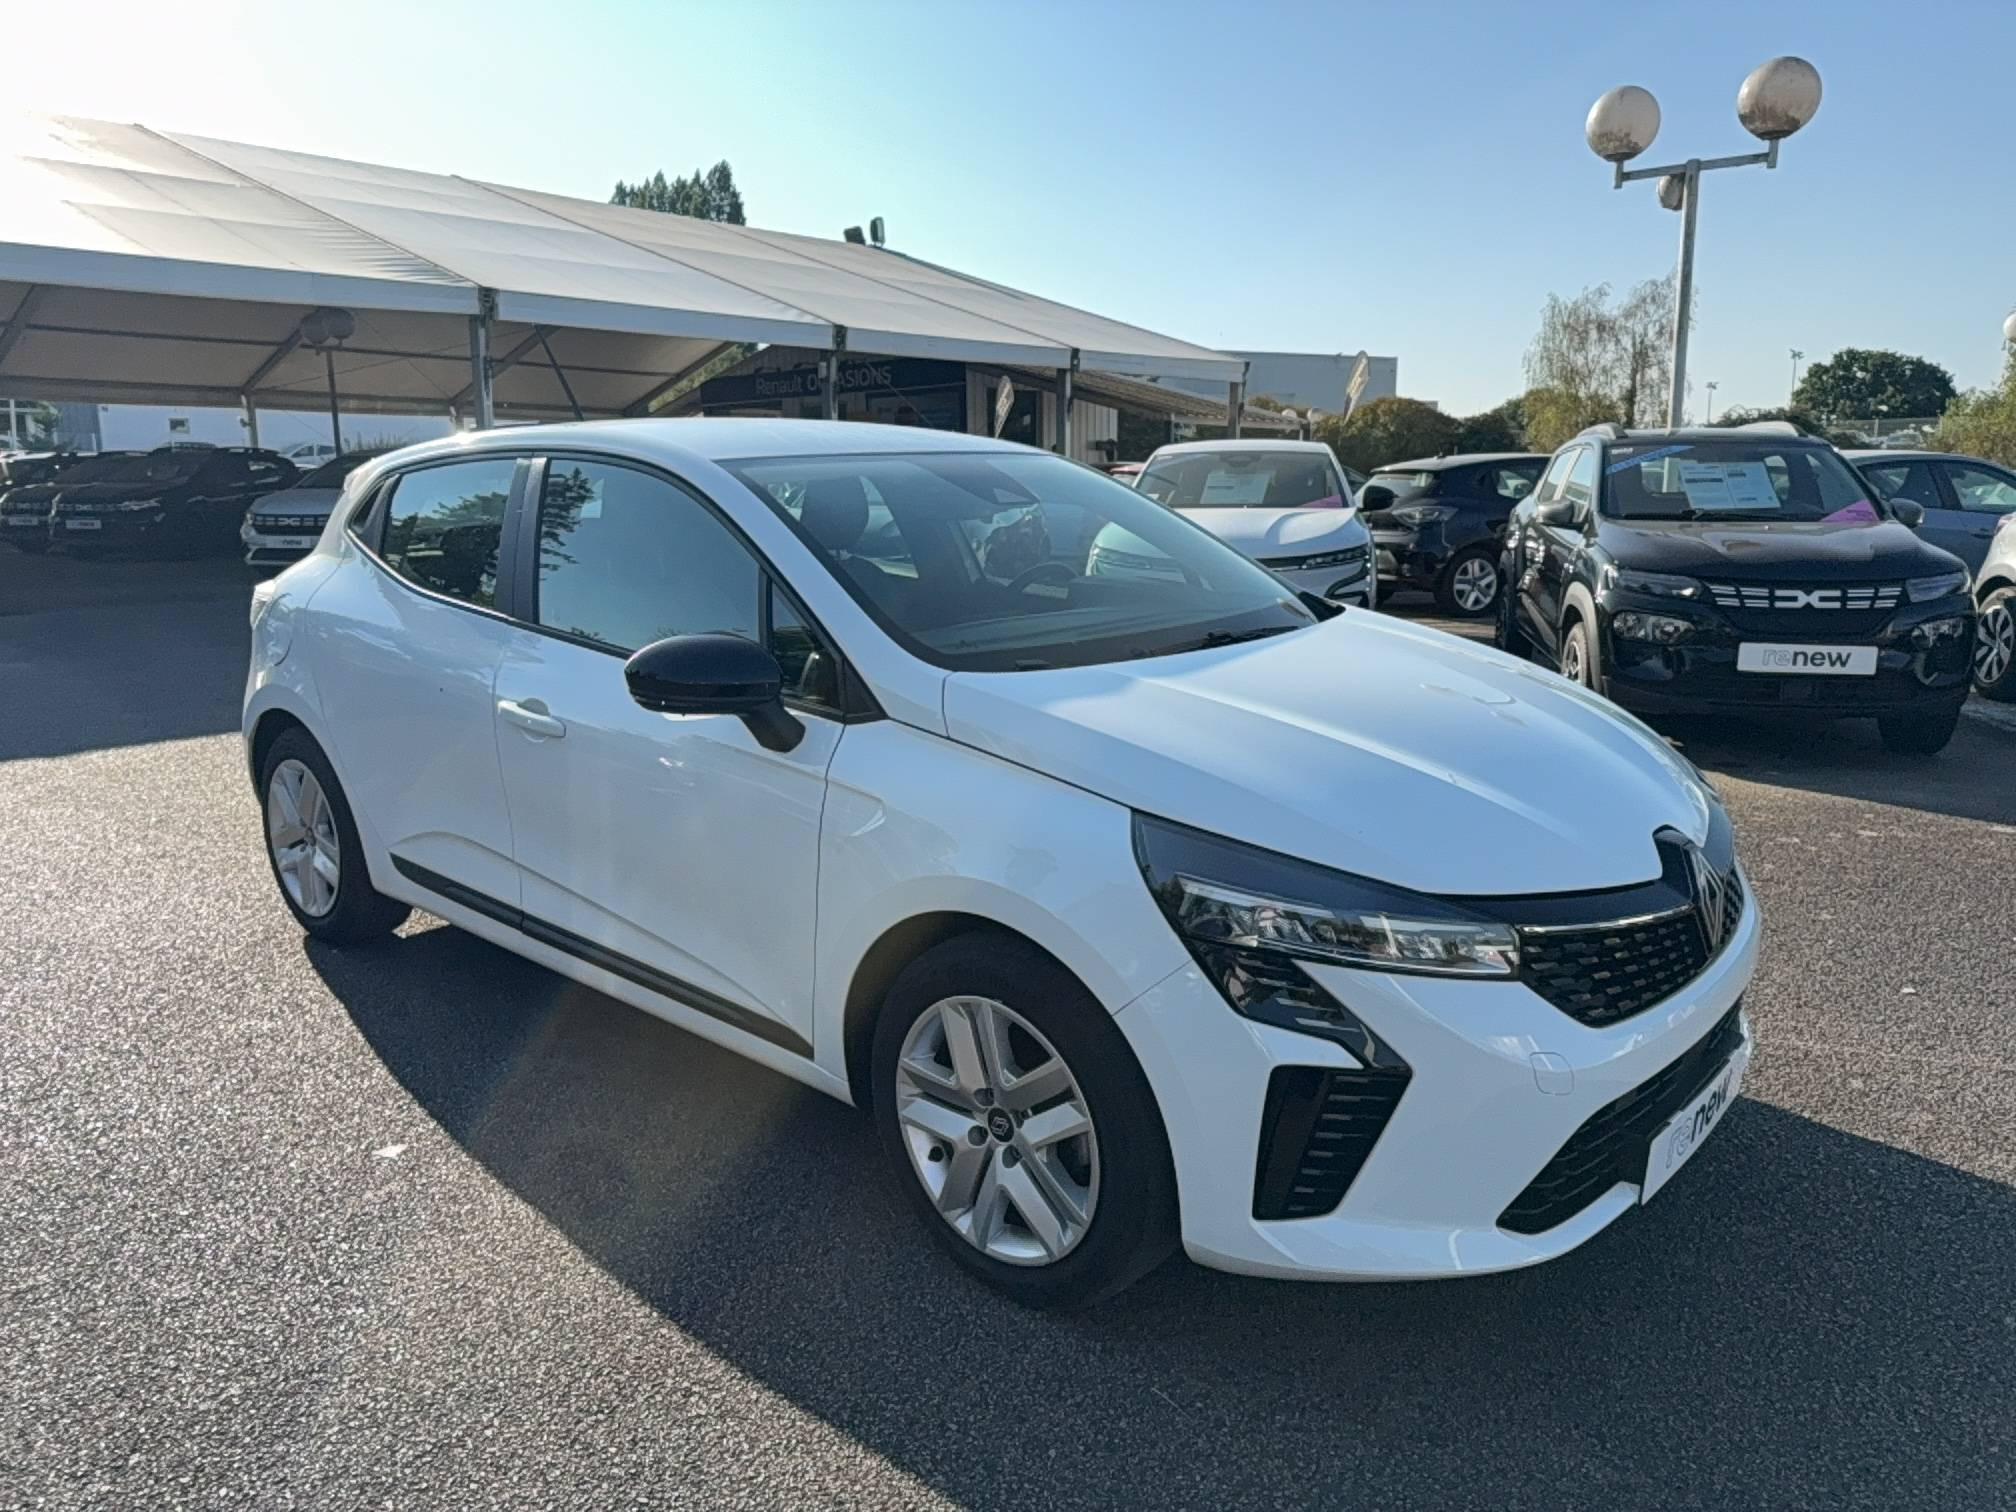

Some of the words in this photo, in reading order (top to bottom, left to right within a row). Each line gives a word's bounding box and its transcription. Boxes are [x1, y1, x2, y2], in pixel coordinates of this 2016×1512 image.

[756, 374, 802, 395] Renault
[807, 365, 892, 392] OASIONS
[1762, 649, 1852, 668] renew
[1666, 1068, 1733, 1169] renew
